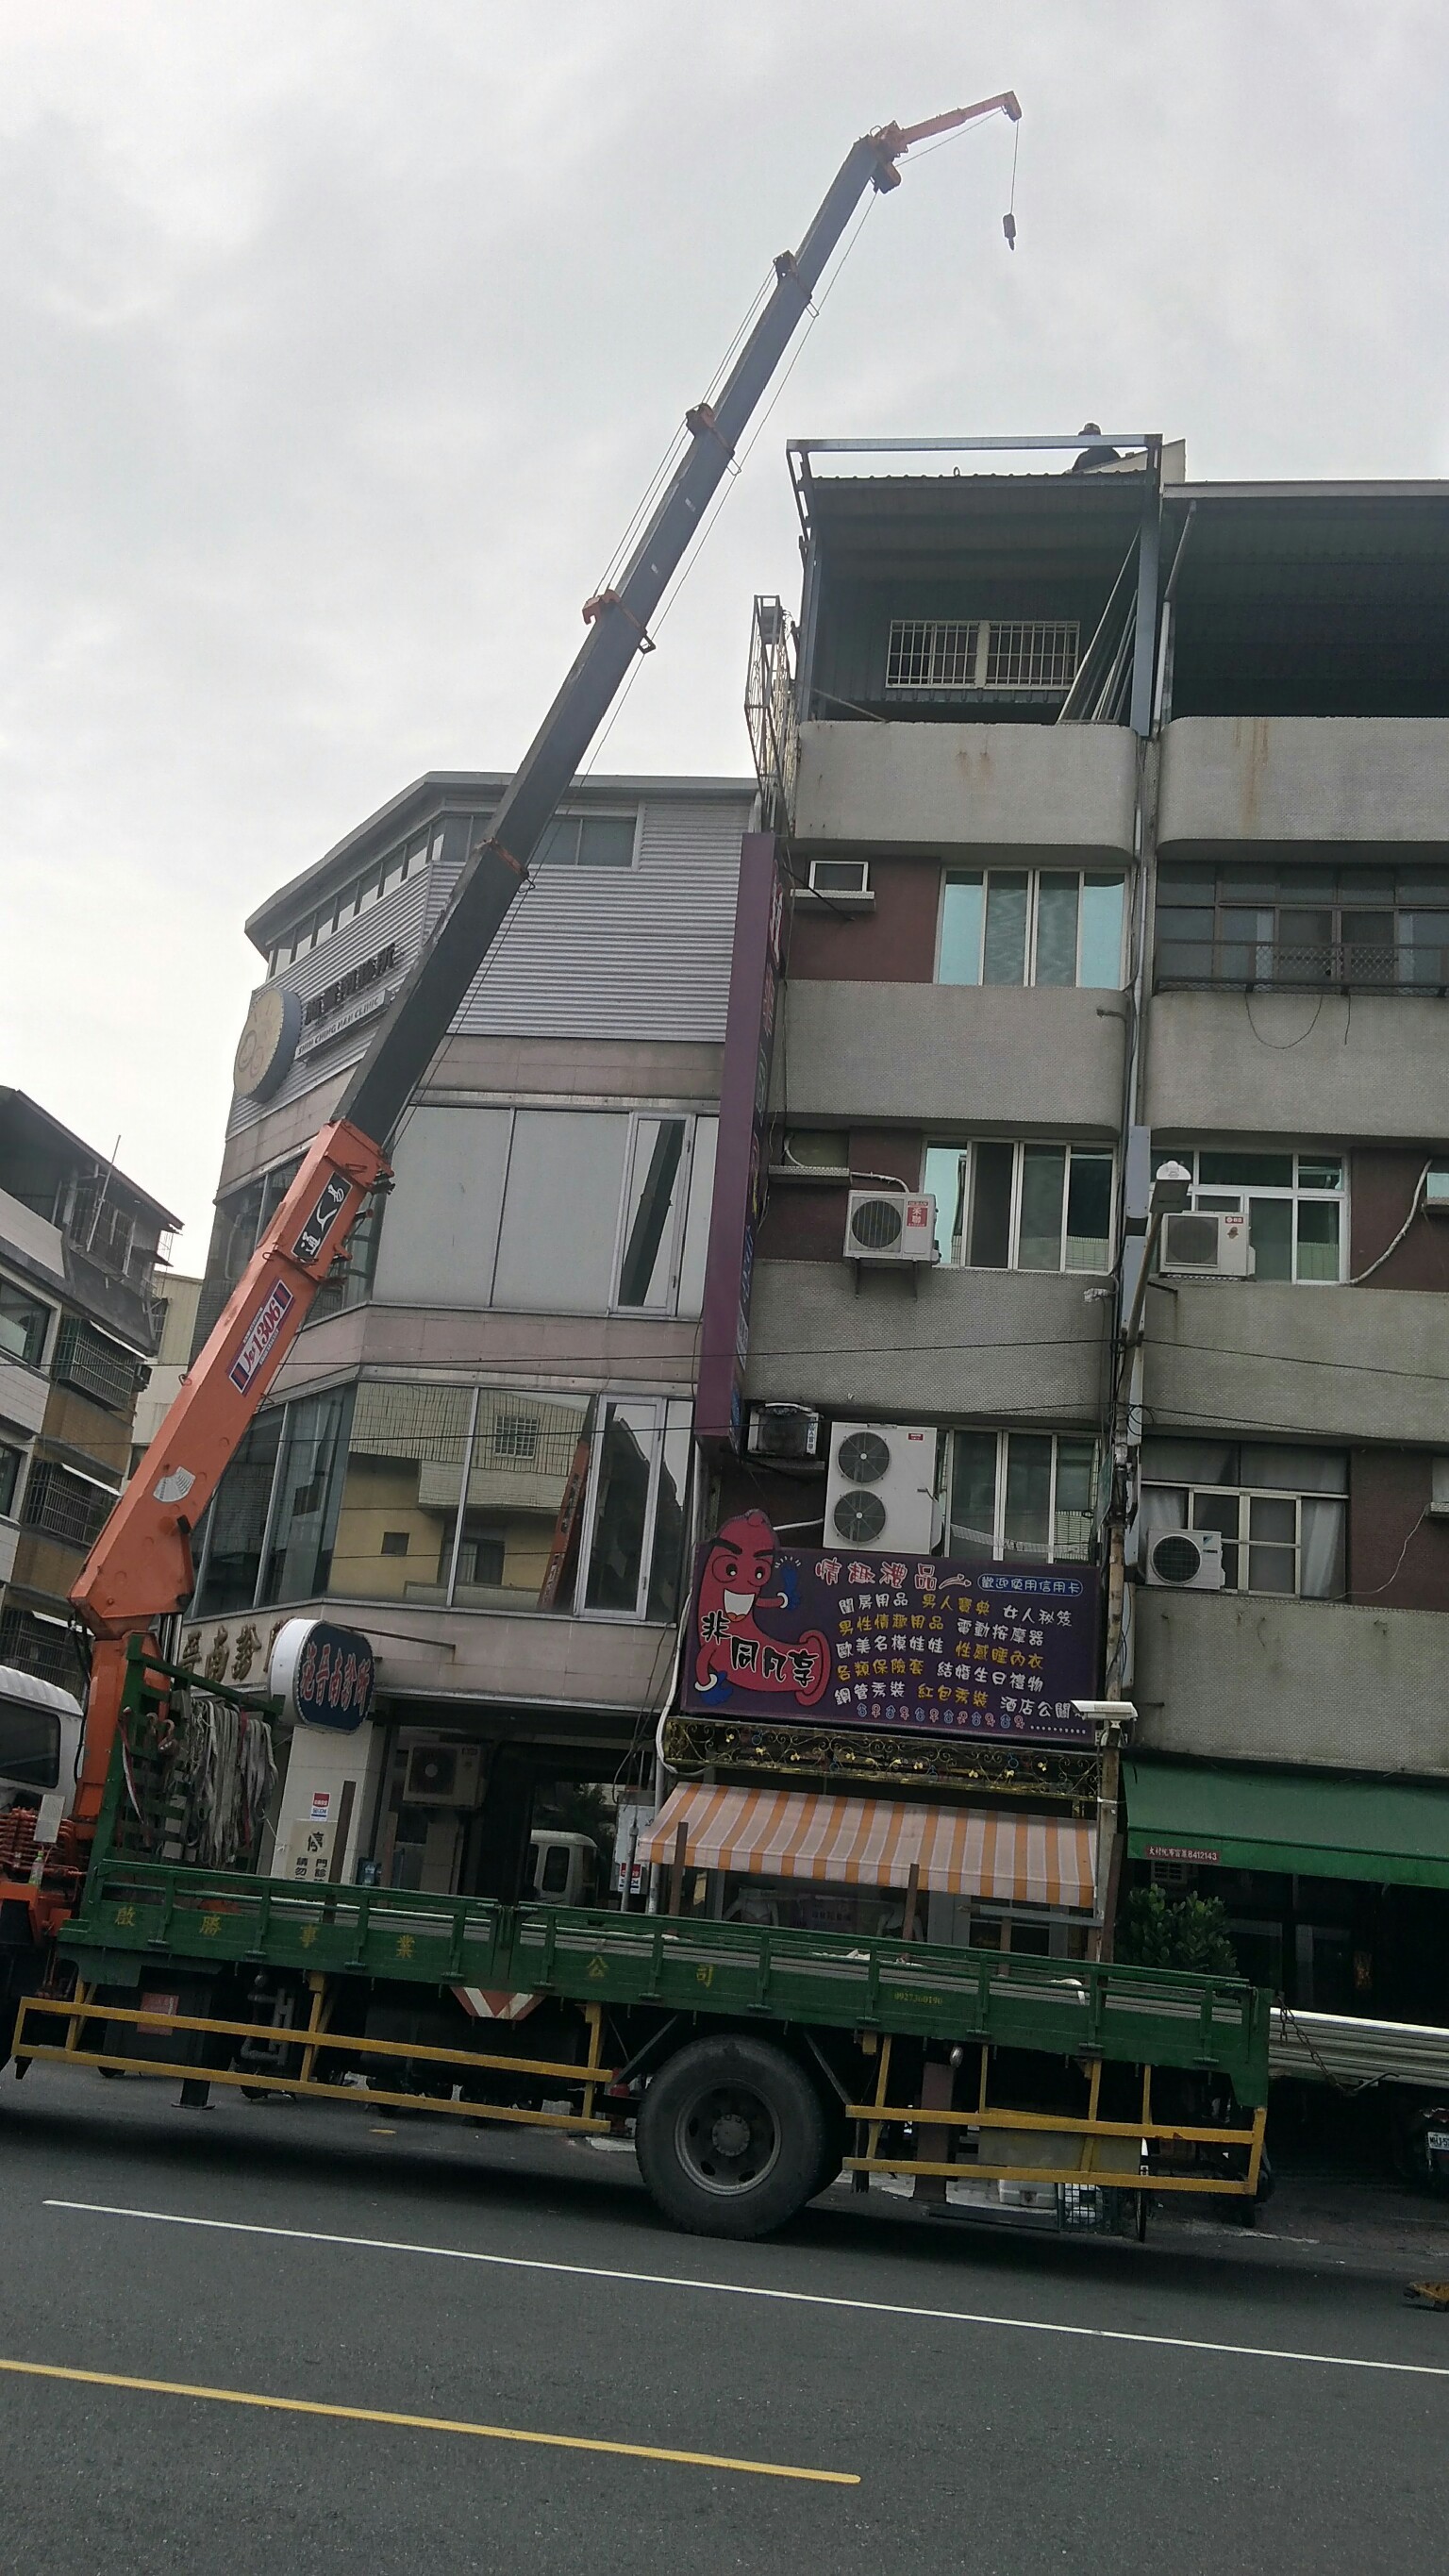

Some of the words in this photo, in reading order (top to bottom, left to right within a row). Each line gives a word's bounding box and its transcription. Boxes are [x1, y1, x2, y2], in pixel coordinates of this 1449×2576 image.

[815, 1557, 938, 1591] 情趣禮品
[981, 1575, 1080, 1595] 歡迎使用信用卡
[838, 1592, 908, 1614] 閨房用品
[922, 1593, 991, 1615] 男人寶典
[1003, 1604, 1073, 1627] 女人秘笈
[838, 1613, 943, 1637] 男性情趣用品
[957, 1617, 1044, 1647] 電動按摩器
[836, 1634, 944, 1659] 歐美名模娃娃
[837, 1658, 924, 1681] 各類保險套
[937, 1661, 1044, 1693] 結婚生日禮物
[834, 1681, 906, 1706] 鋼管秀裝
[917, 1682, 989, 1708] 紅包秀裝
[294, 1856, 308, 1881] 請勿
[314, 1858, 328, 1882] 門診
